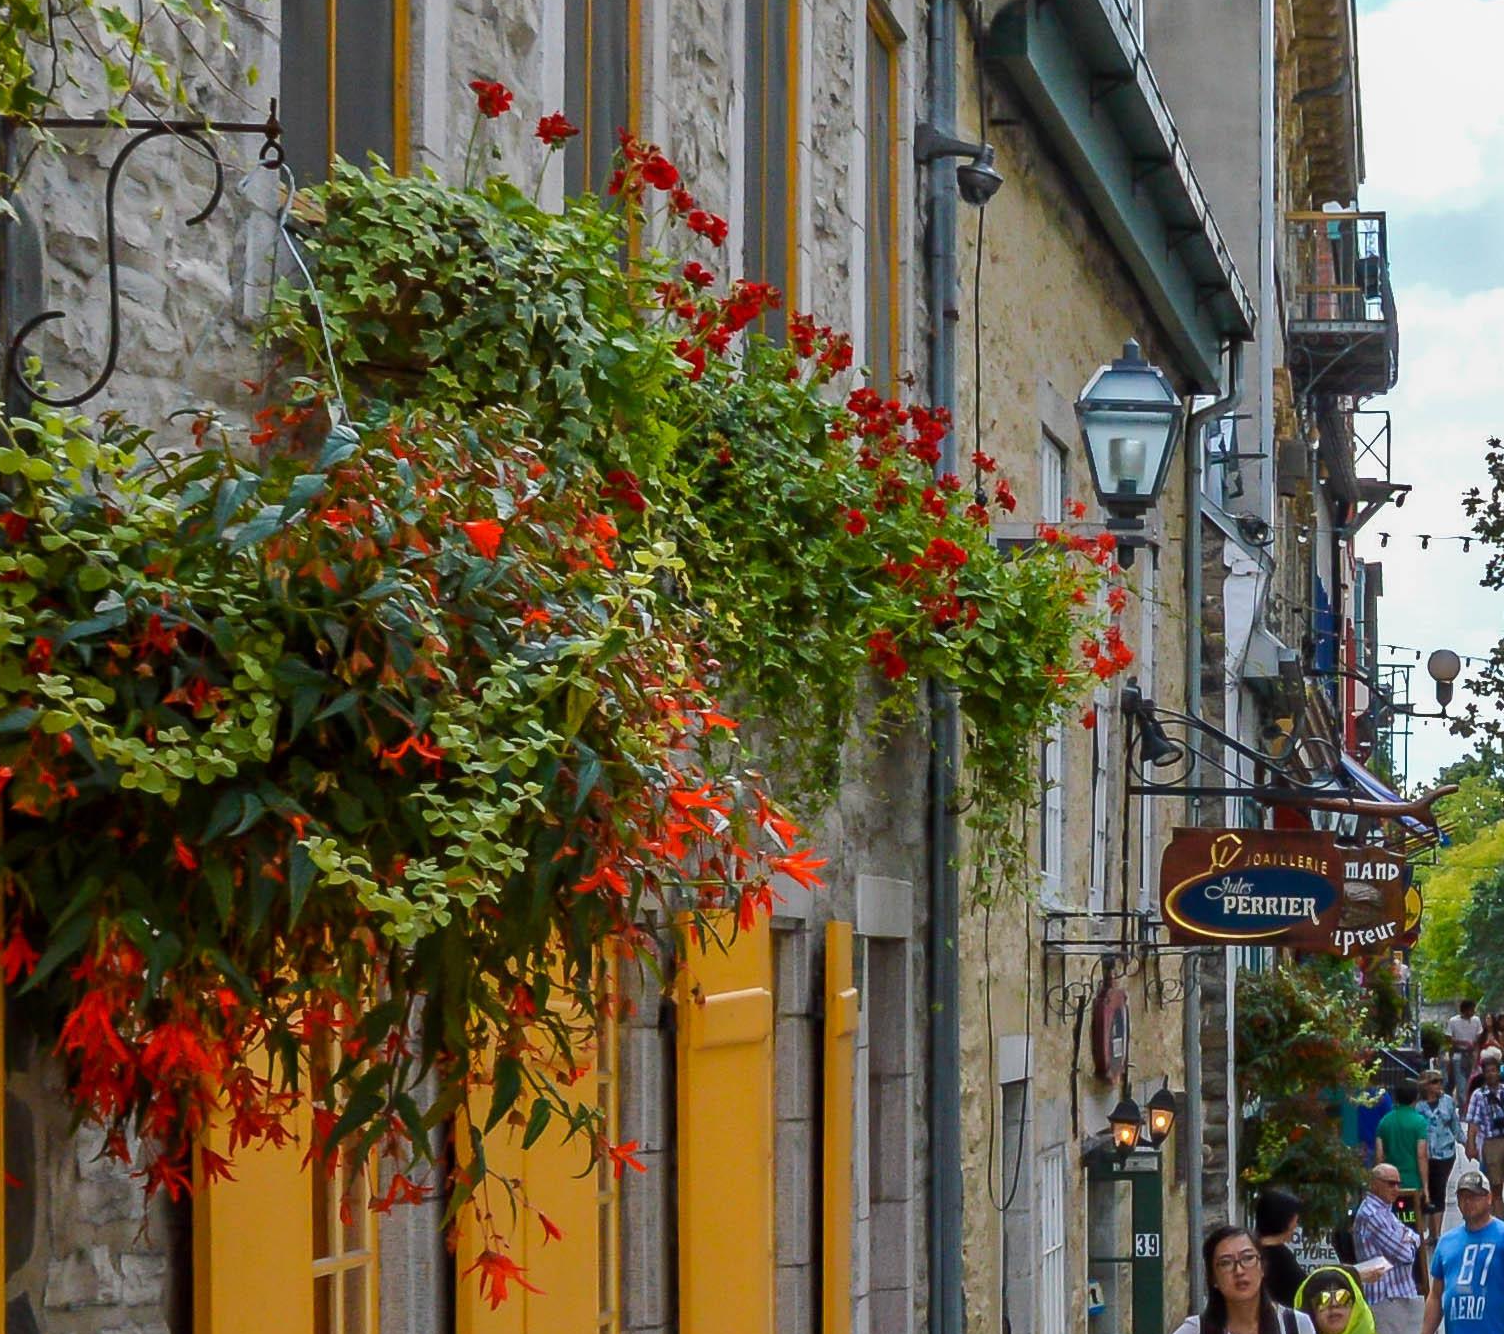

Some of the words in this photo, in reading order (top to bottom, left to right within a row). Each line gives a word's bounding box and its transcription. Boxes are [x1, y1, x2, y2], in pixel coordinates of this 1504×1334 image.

[1244, 853, 1328, 875] JOAILLERIE
[1344, 861, 1400, 881] MAND
[1204, 876, 1255, 900] Jules
[1223, 897, 1320, 925] PERRIER
[1332, 921, 1397, 956] lpteur
[1136, 1234, 1158, 1256] 39
[1457, 1242, 1496, 1286] 87
[1449, 1294, 1486, 1322] AERO
